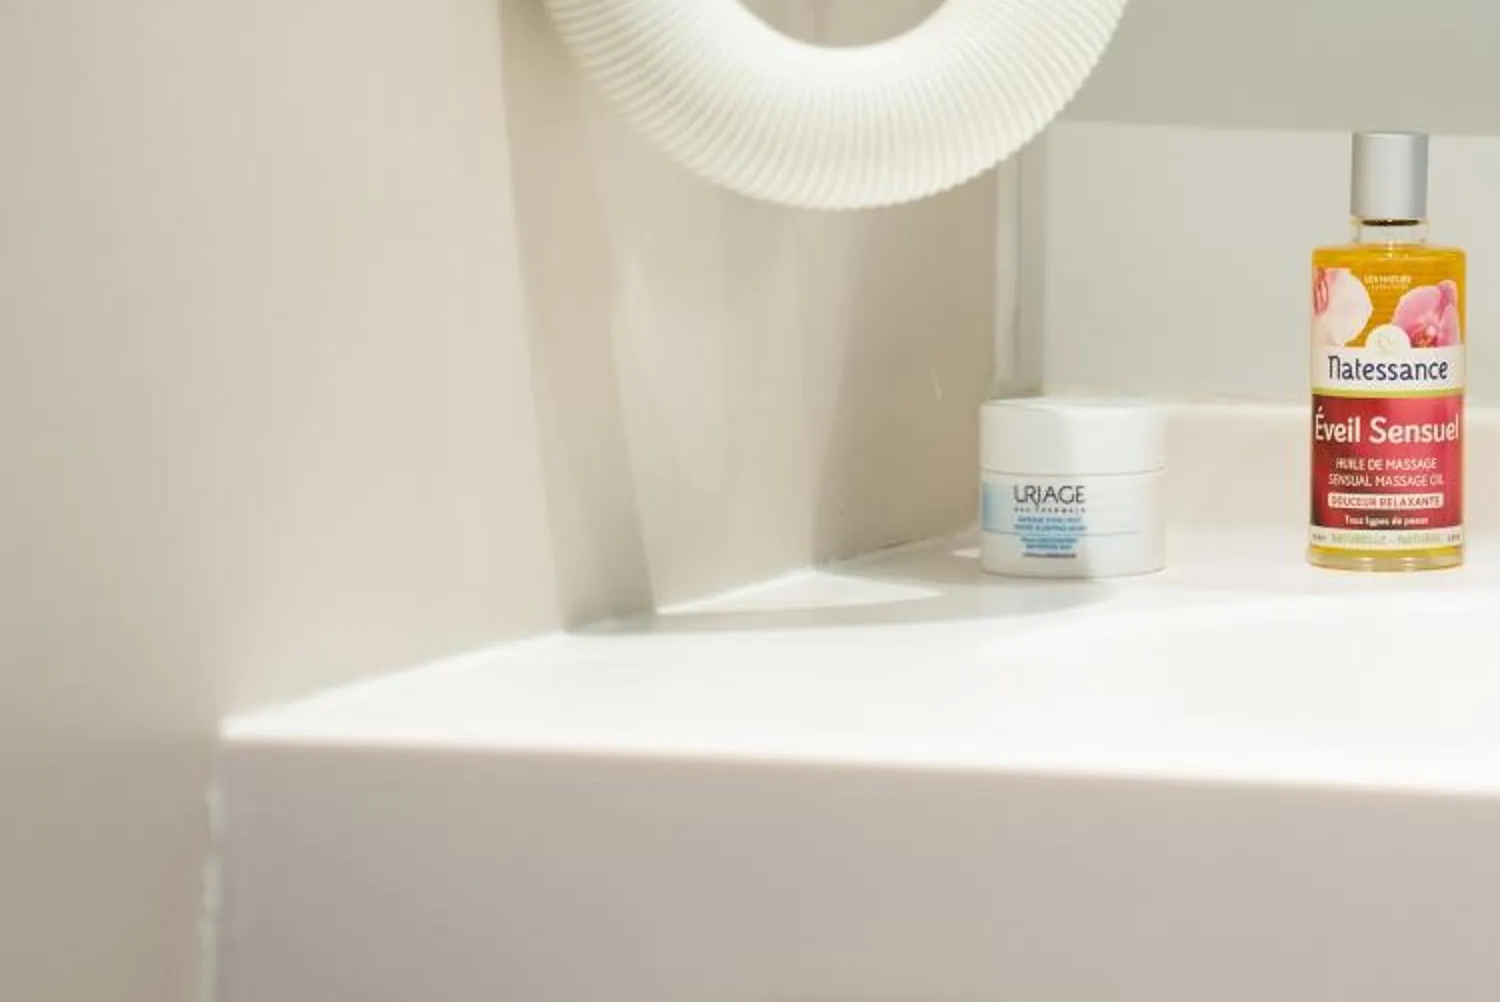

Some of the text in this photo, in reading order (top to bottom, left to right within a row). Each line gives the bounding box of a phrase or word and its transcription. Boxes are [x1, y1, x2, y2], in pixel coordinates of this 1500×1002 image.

[1328, 355, 1449, 381] Natessance
[1315, 406, 1460, 444] Éveil Sensuel
[1335, 457, 1438, 471] HUILE DE MASSAGE
[1328, 473, 1444, 487] SENSUAL MASSAGE OIL
[1013, 485, 1086, 507] URIAGE
[1330, 494, 1441, 507] DOUCEUR RELAXANTE
[1365, 515, 1390, 527] types
